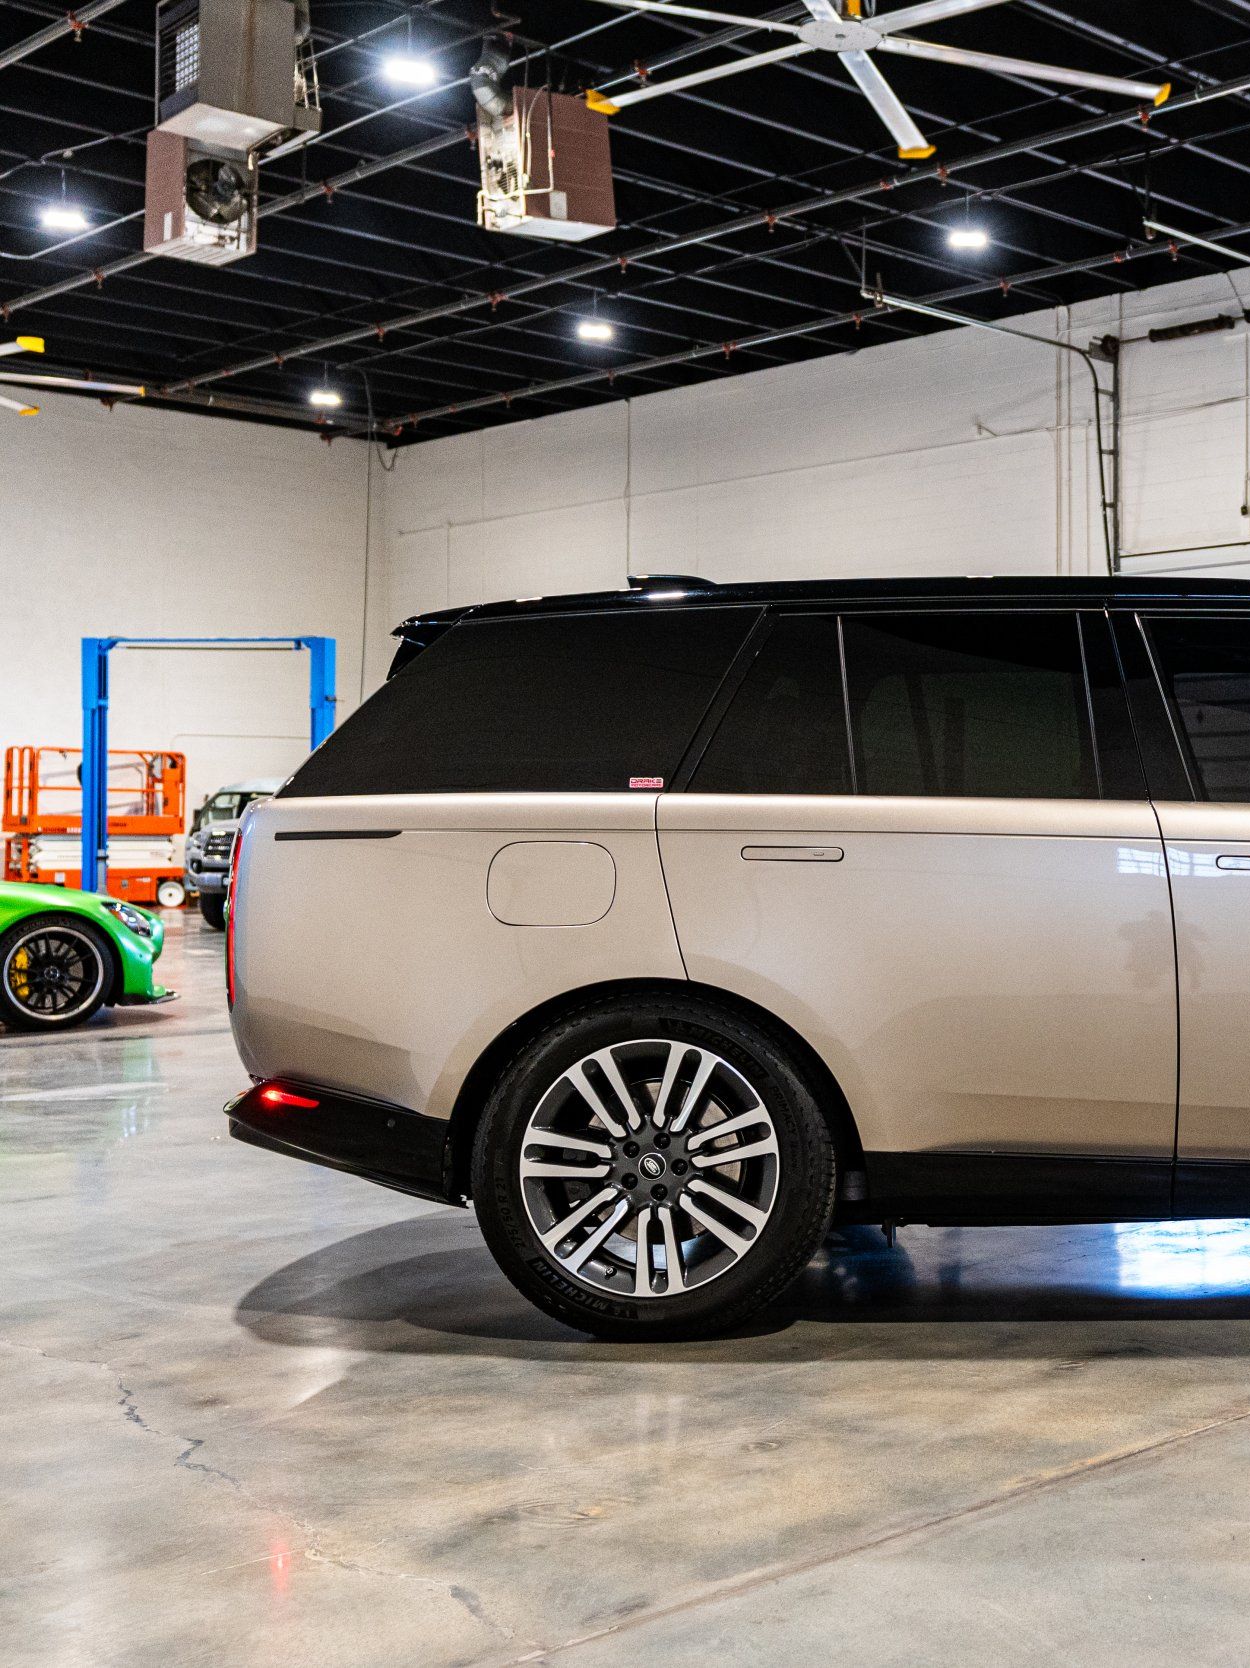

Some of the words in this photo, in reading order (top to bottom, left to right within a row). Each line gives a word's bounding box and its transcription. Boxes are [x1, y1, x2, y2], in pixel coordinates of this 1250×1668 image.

[769, 1085, 797, 1136] PRIMACY
[501, 1206, 527, 1250] 275/50
[533, 1259, 609, 1313] MICHELIN
